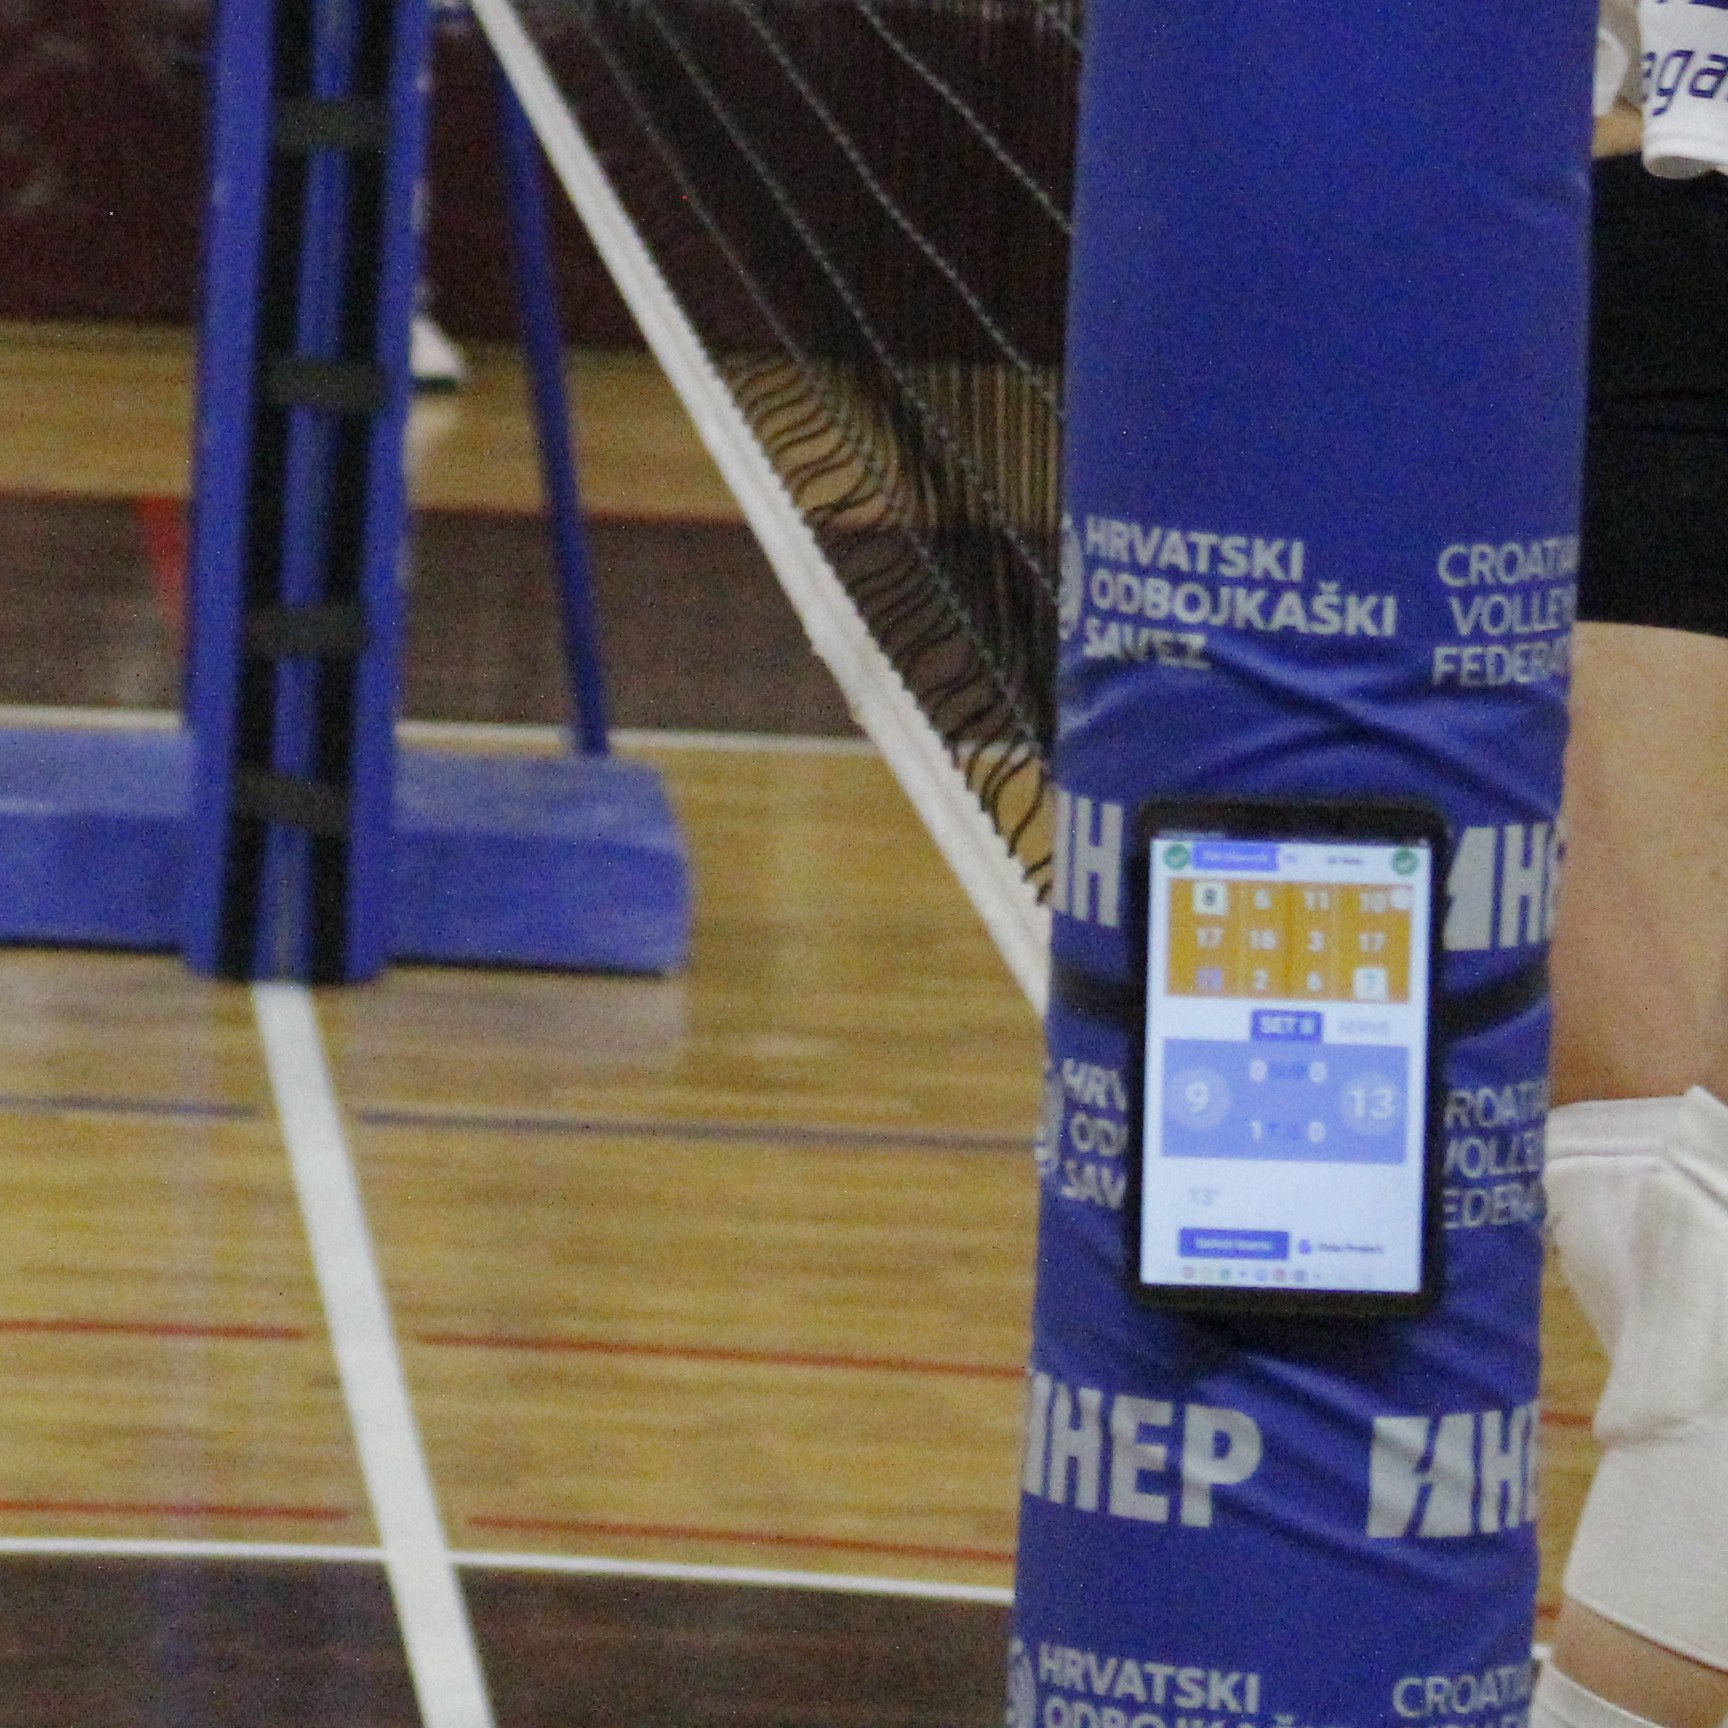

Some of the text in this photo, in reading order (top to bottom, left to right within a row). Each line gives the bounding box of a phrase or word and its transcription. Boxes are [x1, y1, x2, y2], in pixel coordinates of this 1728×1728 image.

[1084, 515, 1304, 582] HRVATSKI
[1092, 568, 1398, 637] ODBOJKAŠKI
[1185, 1080, 1211, 1114] 9
[1348, 1087, 1396, 1121] 13
[1039, 1641, 1262, 1715] HRVATSKI
